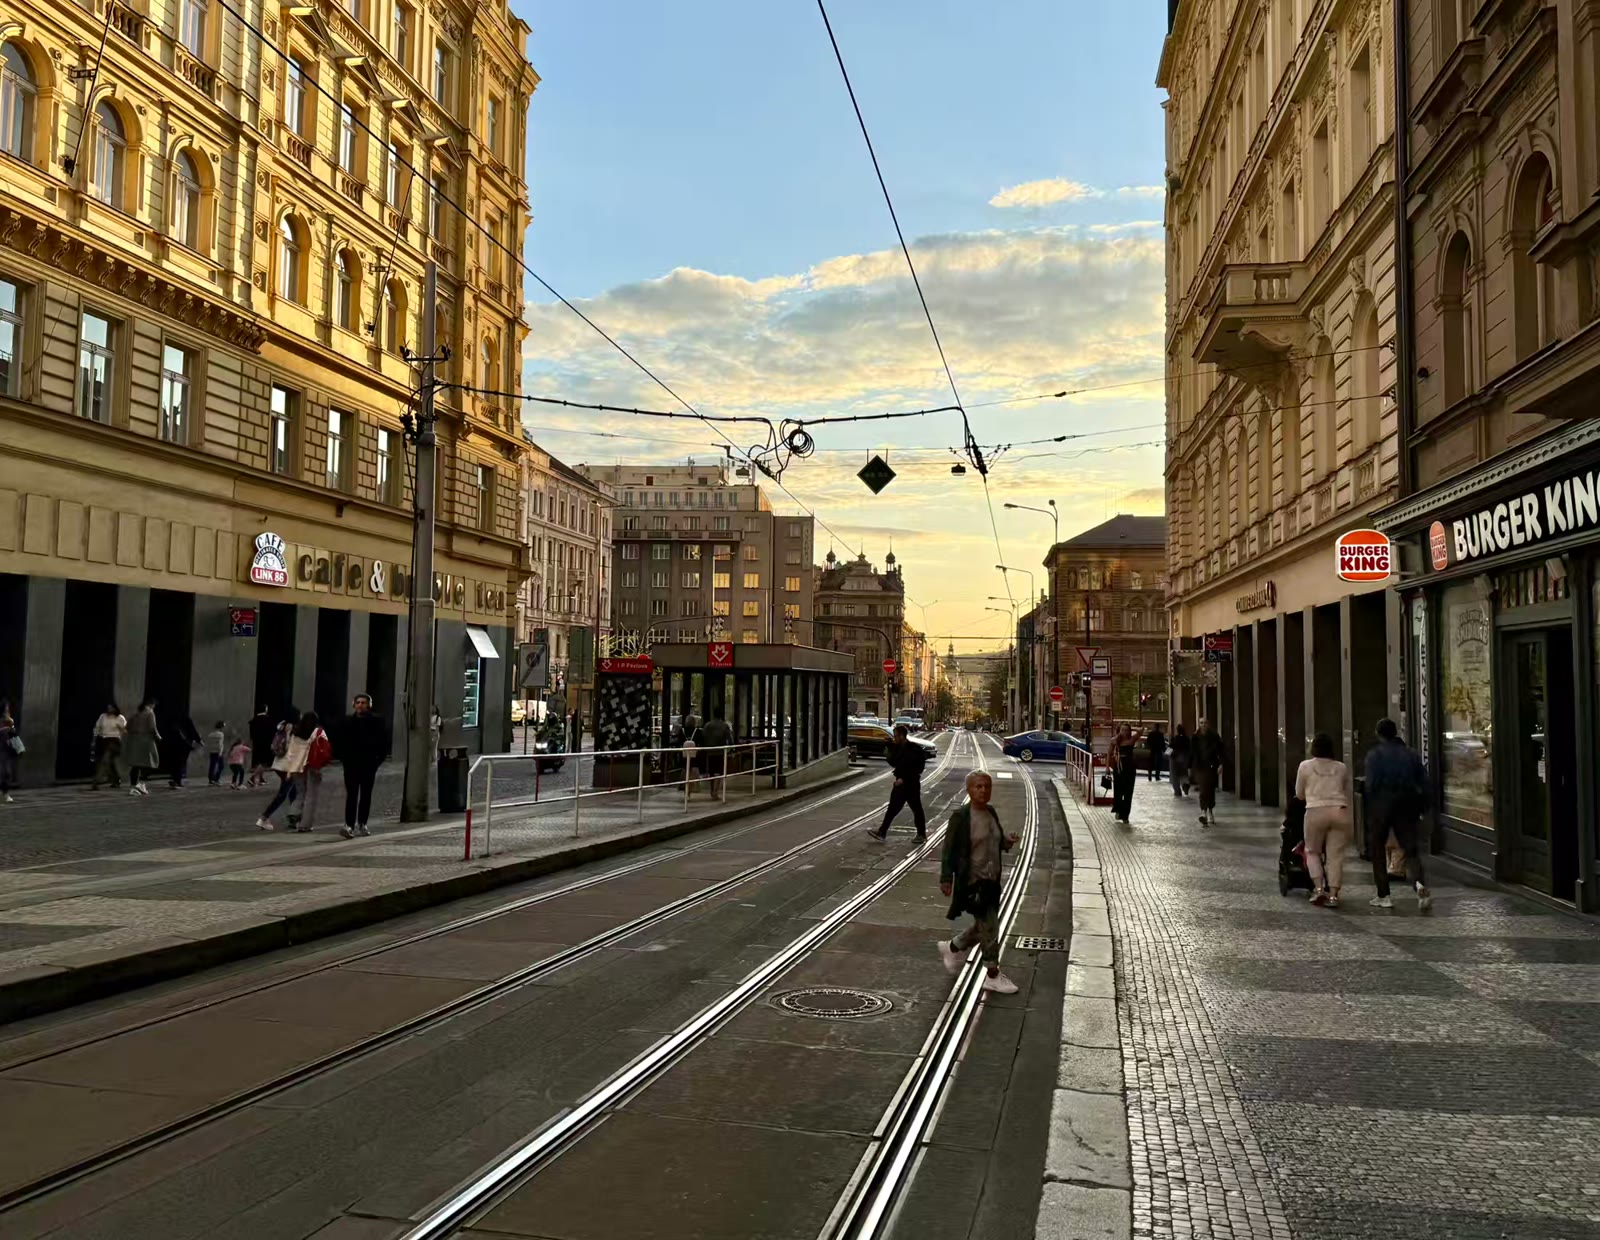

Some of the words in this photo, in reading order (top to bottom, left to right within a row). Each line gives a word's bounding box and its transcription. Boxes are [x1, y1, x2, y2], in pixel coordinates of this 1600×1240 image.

[1452, 492, 1542, 561] BURGER
[1544, 470, 1600, 535] KIN
[256, 533, 284, 551] CAFE
[1340, 546, 1389, 556] BURGER
[1340, 557, 1389, 571] KING
[255, 568, 273, 581] LINK
[274, 572, 285, 583] 86
[299, 554, 362, 590] cafe
[370, 560, 385, 593] &
[477, 583, 505, 611] tea
